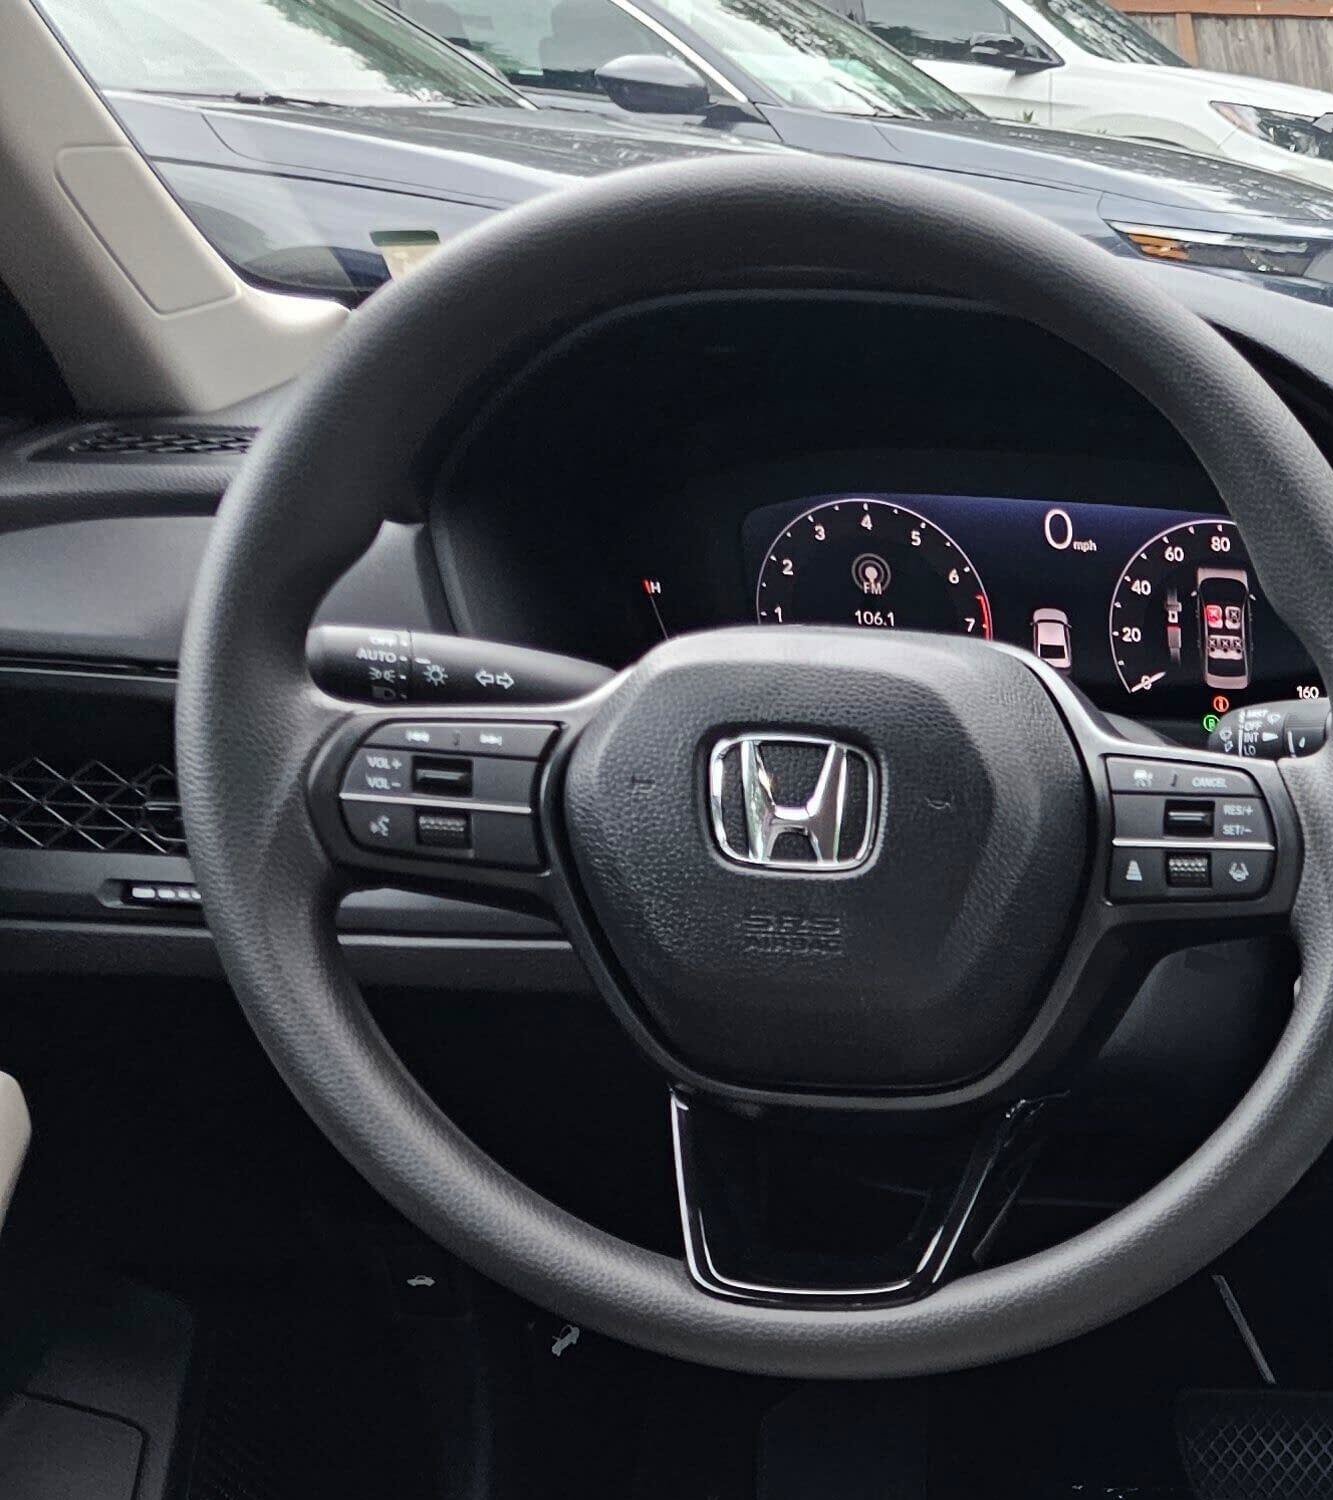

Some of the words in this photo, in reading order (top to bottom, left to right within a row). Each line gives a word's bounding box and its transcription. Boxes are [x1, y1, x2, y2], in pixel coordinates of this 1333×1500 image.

[860, 514, 873, 531] 4
[814, 525, 826, 541] 3
[1044, 508, 1073, 550] 0
[1073, 540, 1097, 553] mph
[911, 531, 922, 546] 5
[1210, 536, 1231, 552] 80
[1164, 547, 1184, 562] 60
[782, 559, 794, 576] 2
[949, 568, 960, 584] 6
[650, 580, 661, 594] H
[863, 582, 882, 595] FM
[1130, 580, 1151, 596] 40
[774, 607, 783, 623] 1
[855, 609, 895, 627] 106.1
[964, 617, 976, 632] 7
[1122, 627, 1142, 642] 20
[355, 648, 397, 663] AUTO
[1296, 685, 1320, 699] 160
[1244, 721, 1263, 731] OFF
[1243, 732, 1260, 743] INT
[1243, 745, 1257, 756] LO
[1192, 776, 1227, 789] CANCEL
